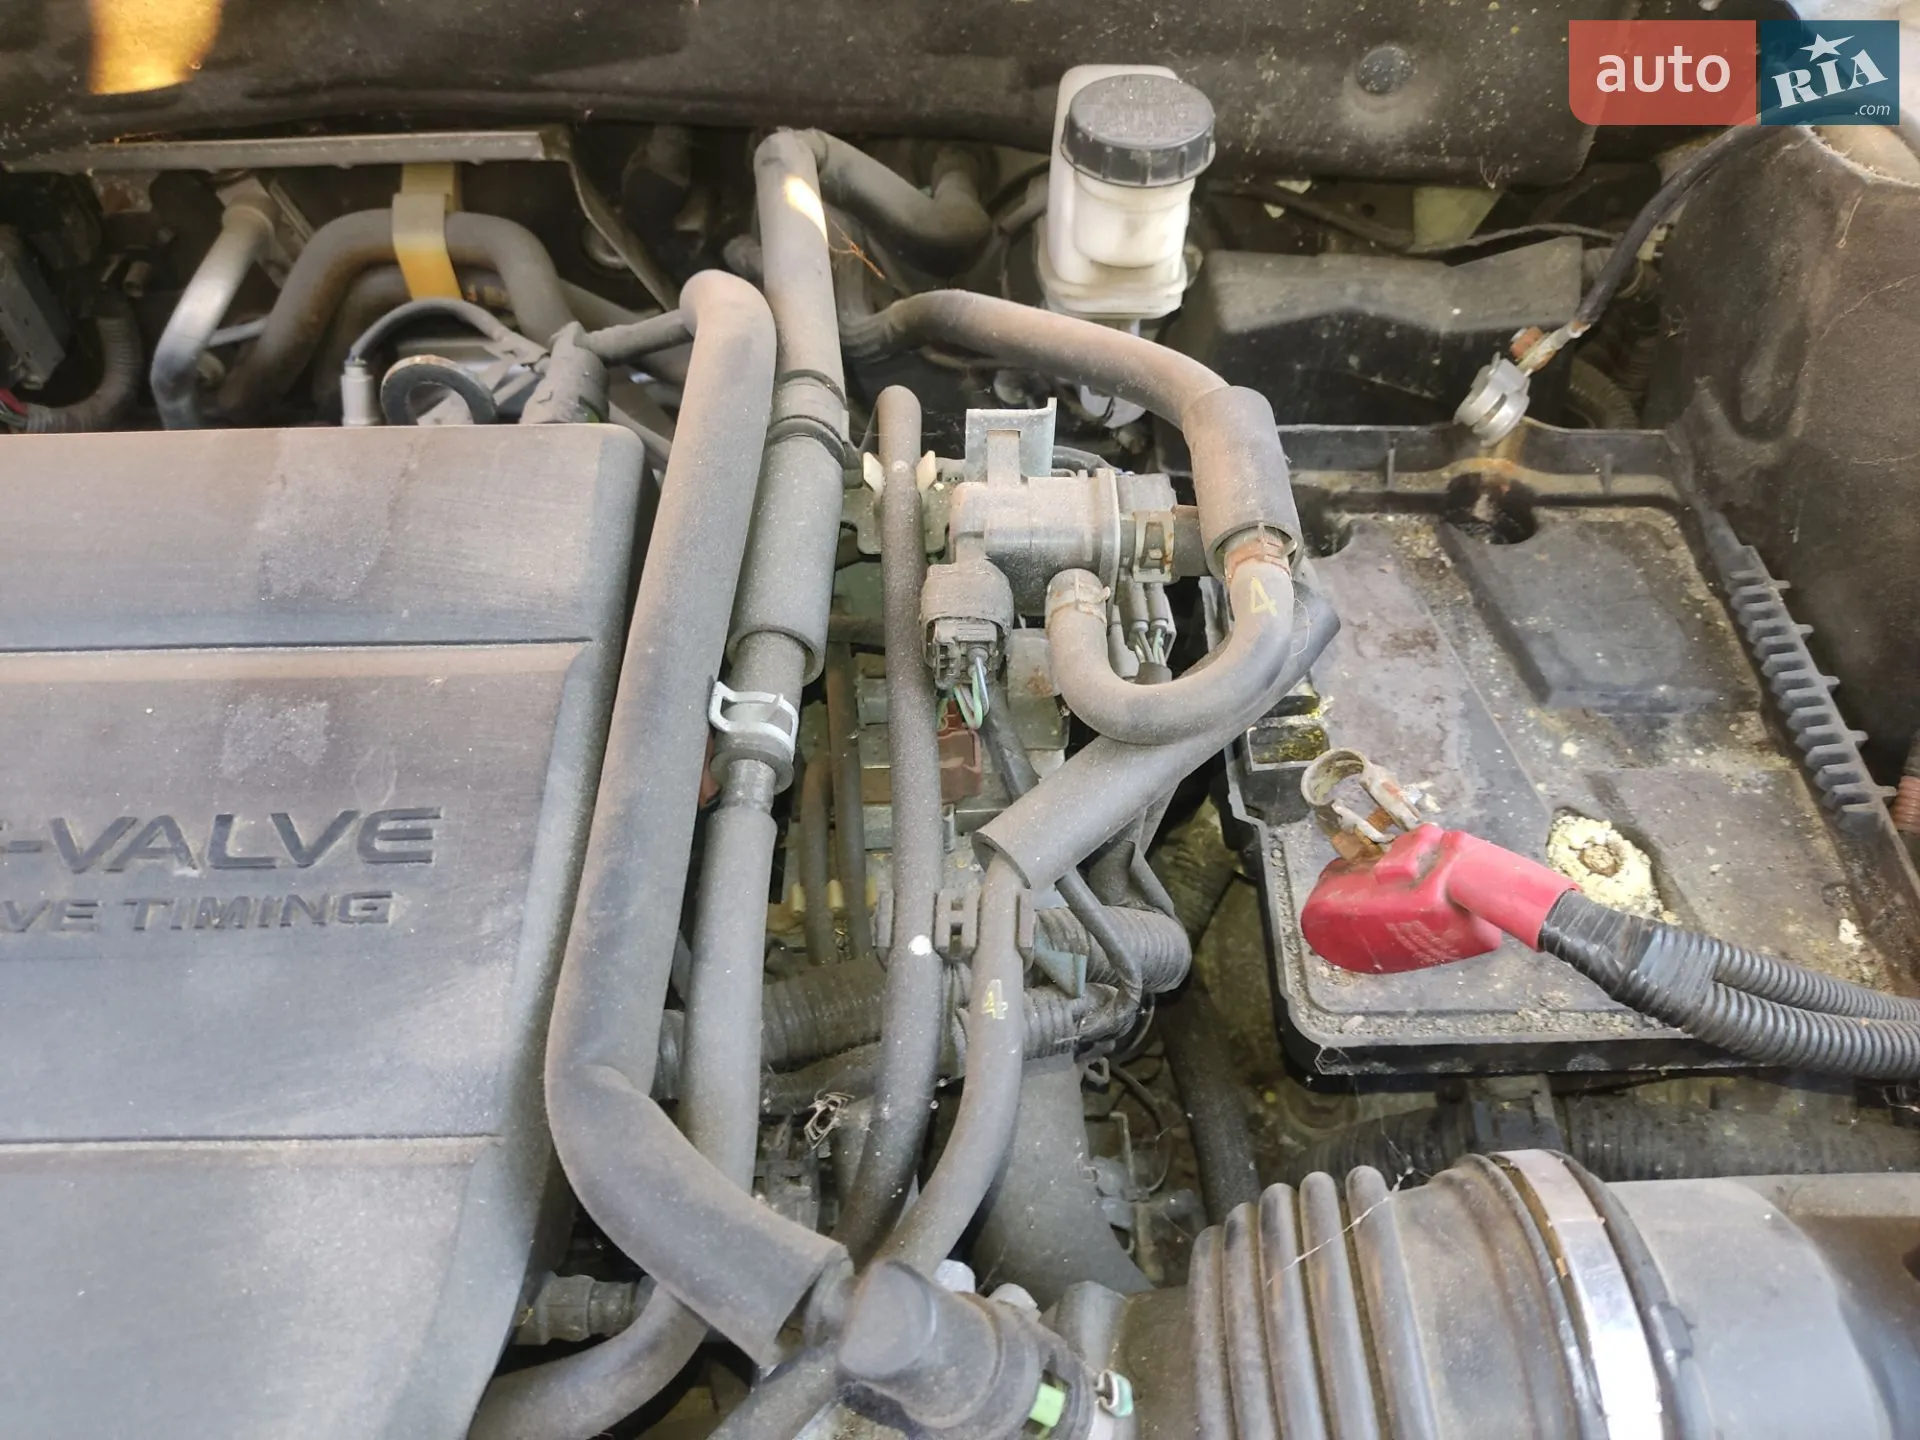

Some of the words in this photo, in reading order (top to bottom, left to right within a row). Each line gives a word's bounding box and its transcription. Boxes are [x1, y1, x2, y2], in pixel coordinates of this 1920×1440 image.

[1250, 576, 1278, 618] 4
[0, 807, 442, 874] -VALVE
[122, 890, 394, 932] TIMING
